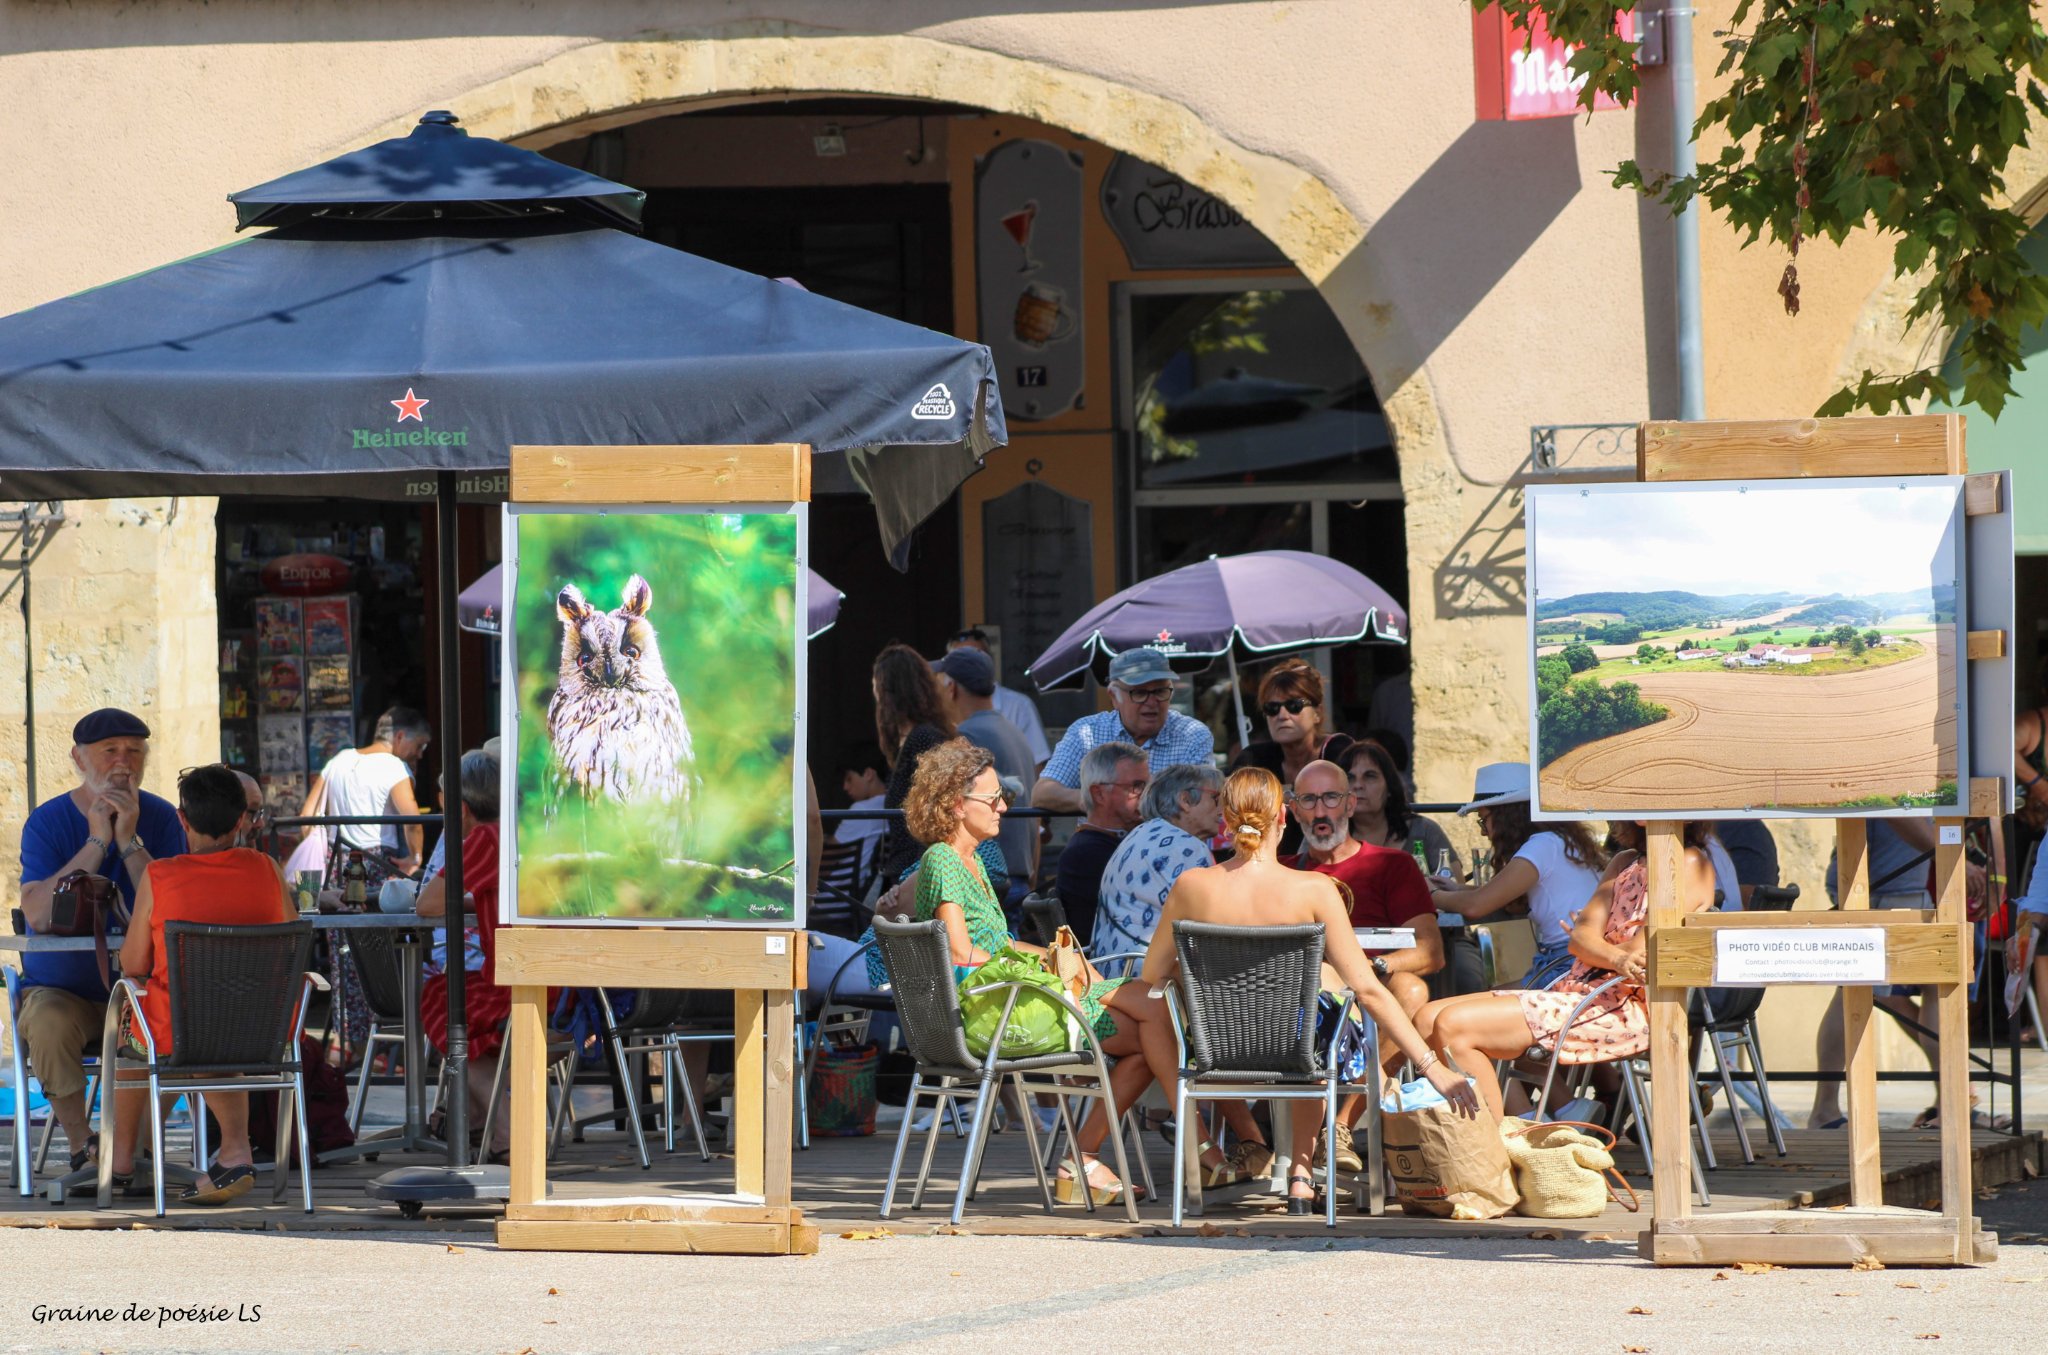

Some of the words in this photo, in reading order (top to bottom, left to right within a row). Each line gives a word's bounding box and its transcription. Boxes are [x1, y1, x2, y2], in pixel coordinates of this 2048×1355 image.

[1022, 367, 1041, 385] 17
[352, 424, 469, 449] Heineken
[1729, 943, 1760, 952] PHOTO
[1763, 940, 1790, 952] VIDÉO
[1793, 943, 1818, 951] CLUB
[1821, 942, 1875, 951] MIRANDAIS
